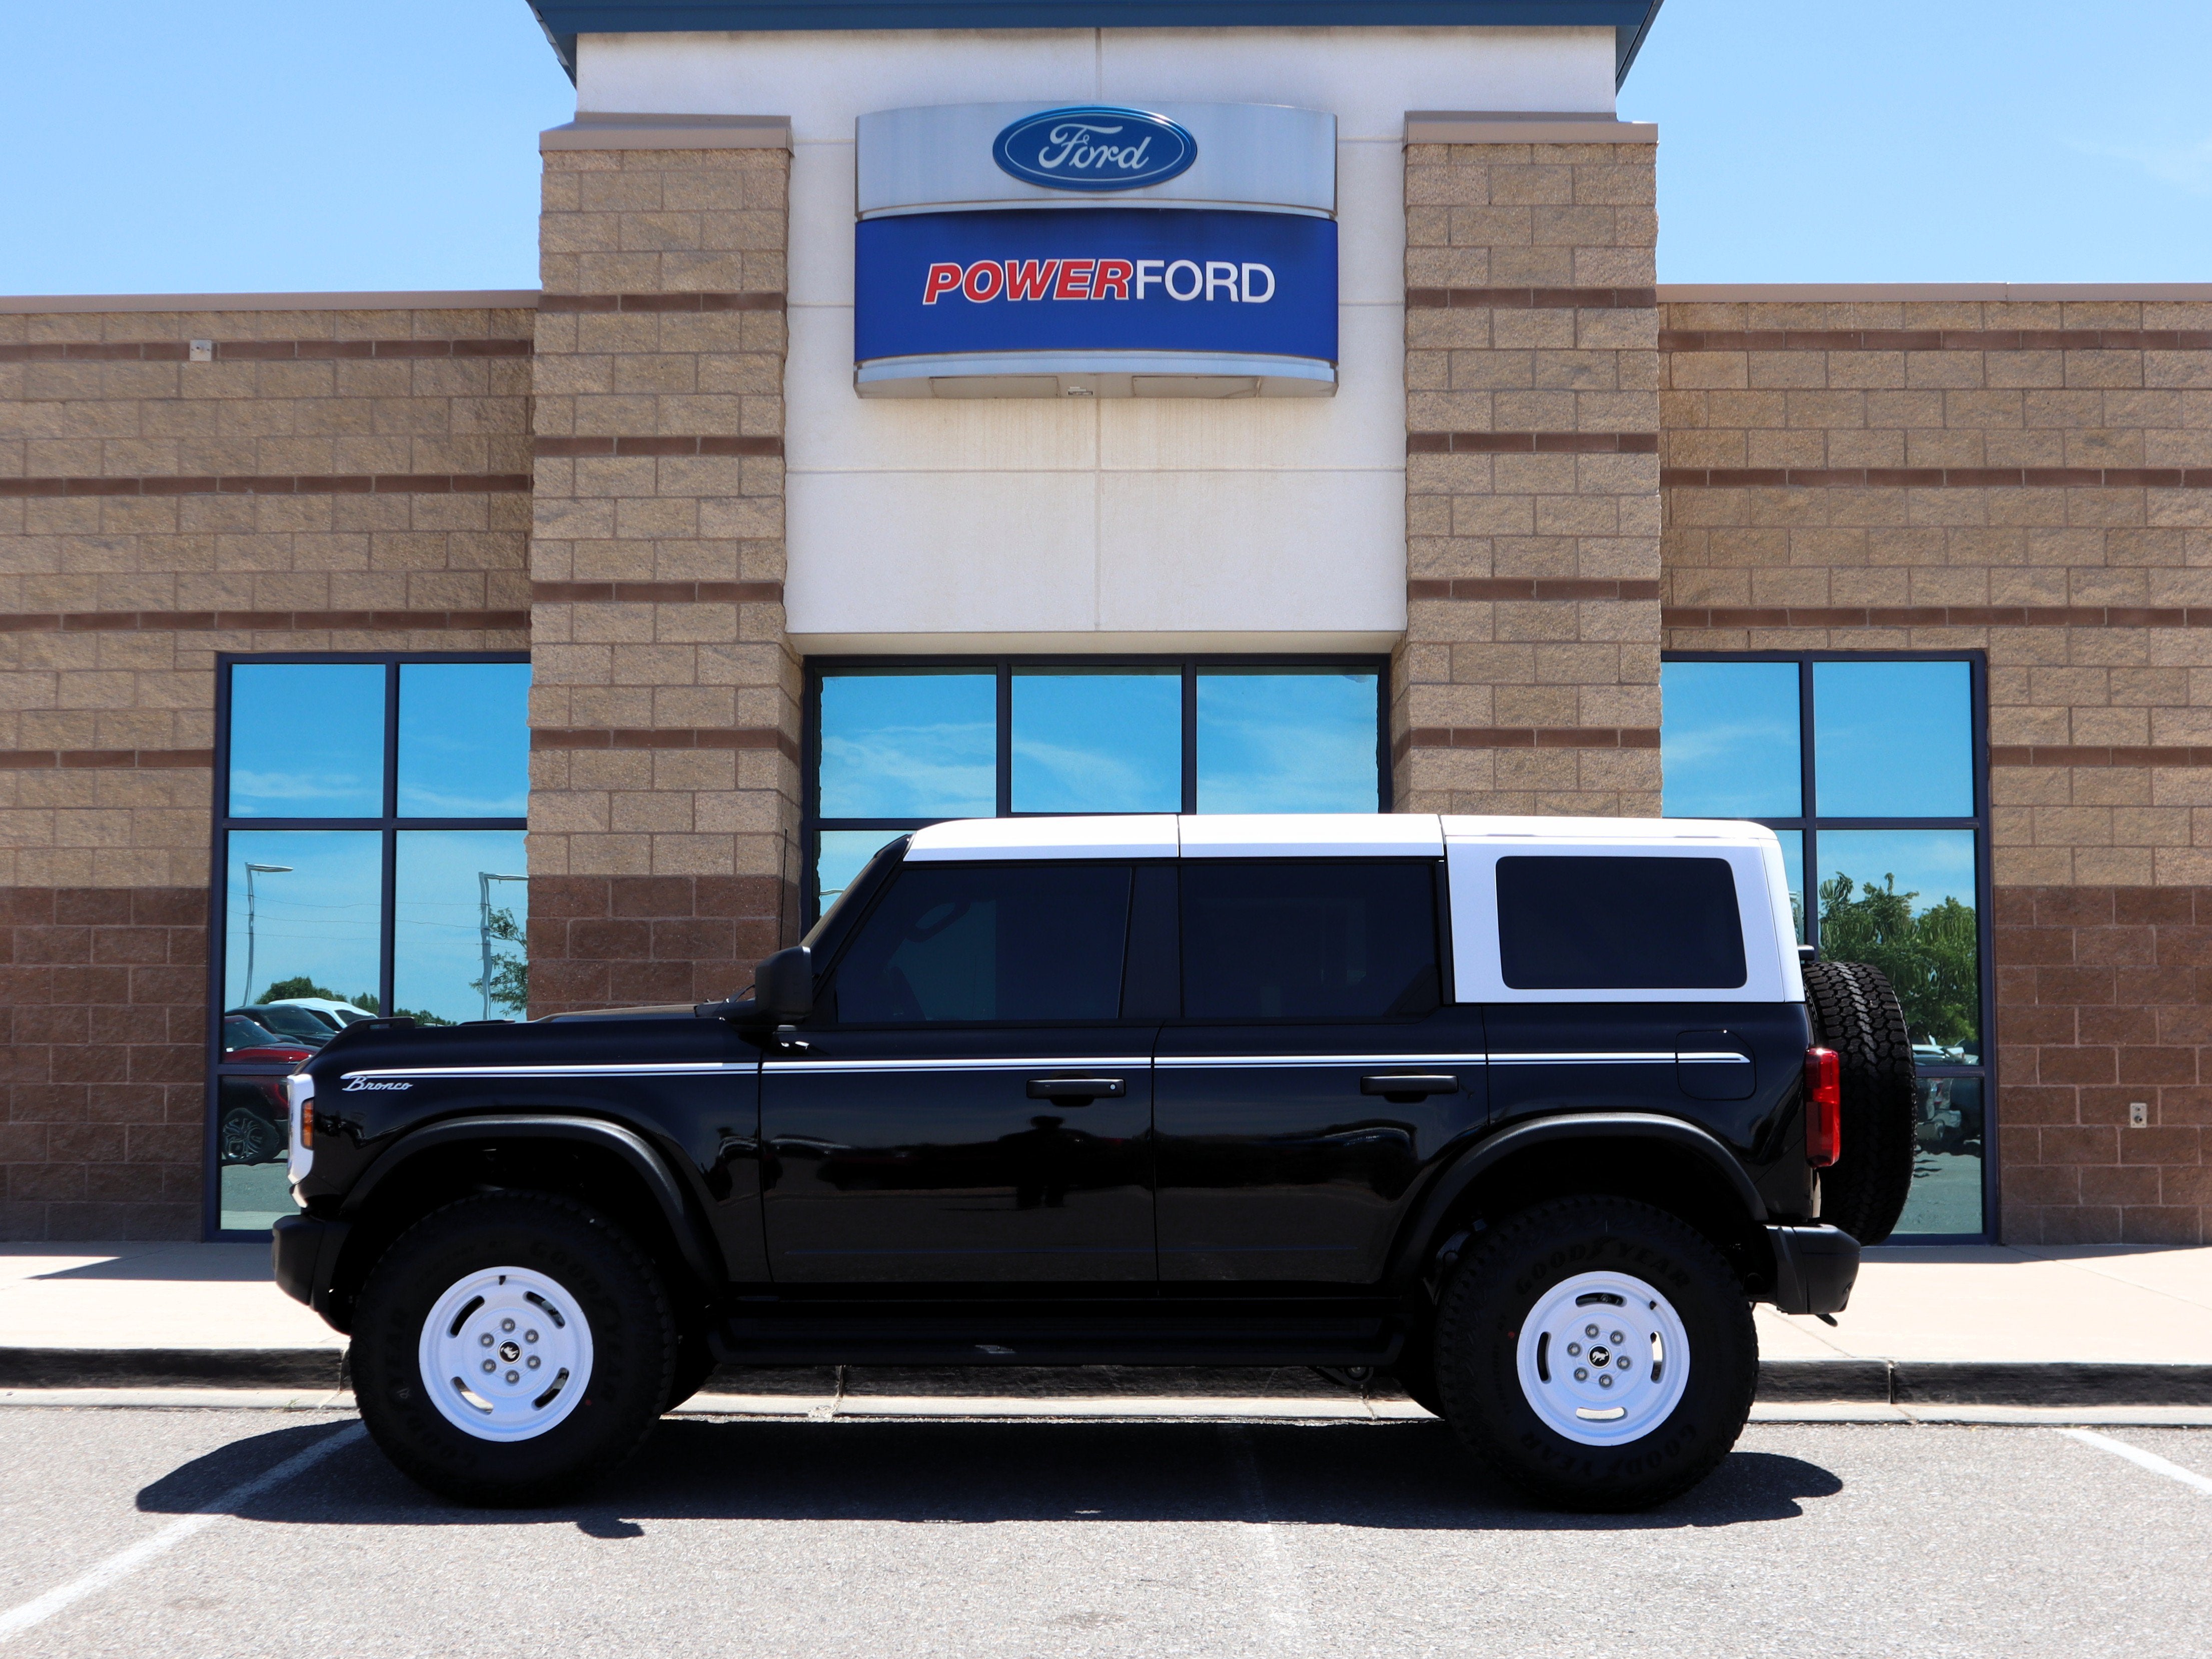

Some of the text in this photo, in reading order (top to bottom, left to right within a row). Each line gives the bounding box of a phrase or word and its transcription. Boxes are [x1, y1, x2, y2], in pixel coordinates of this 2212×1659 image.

[1038, 122, 1151, 170] Ford
[922, 258, 1276, 306] POWERFORD
[342, 1075, 414, 1092] Bronco
